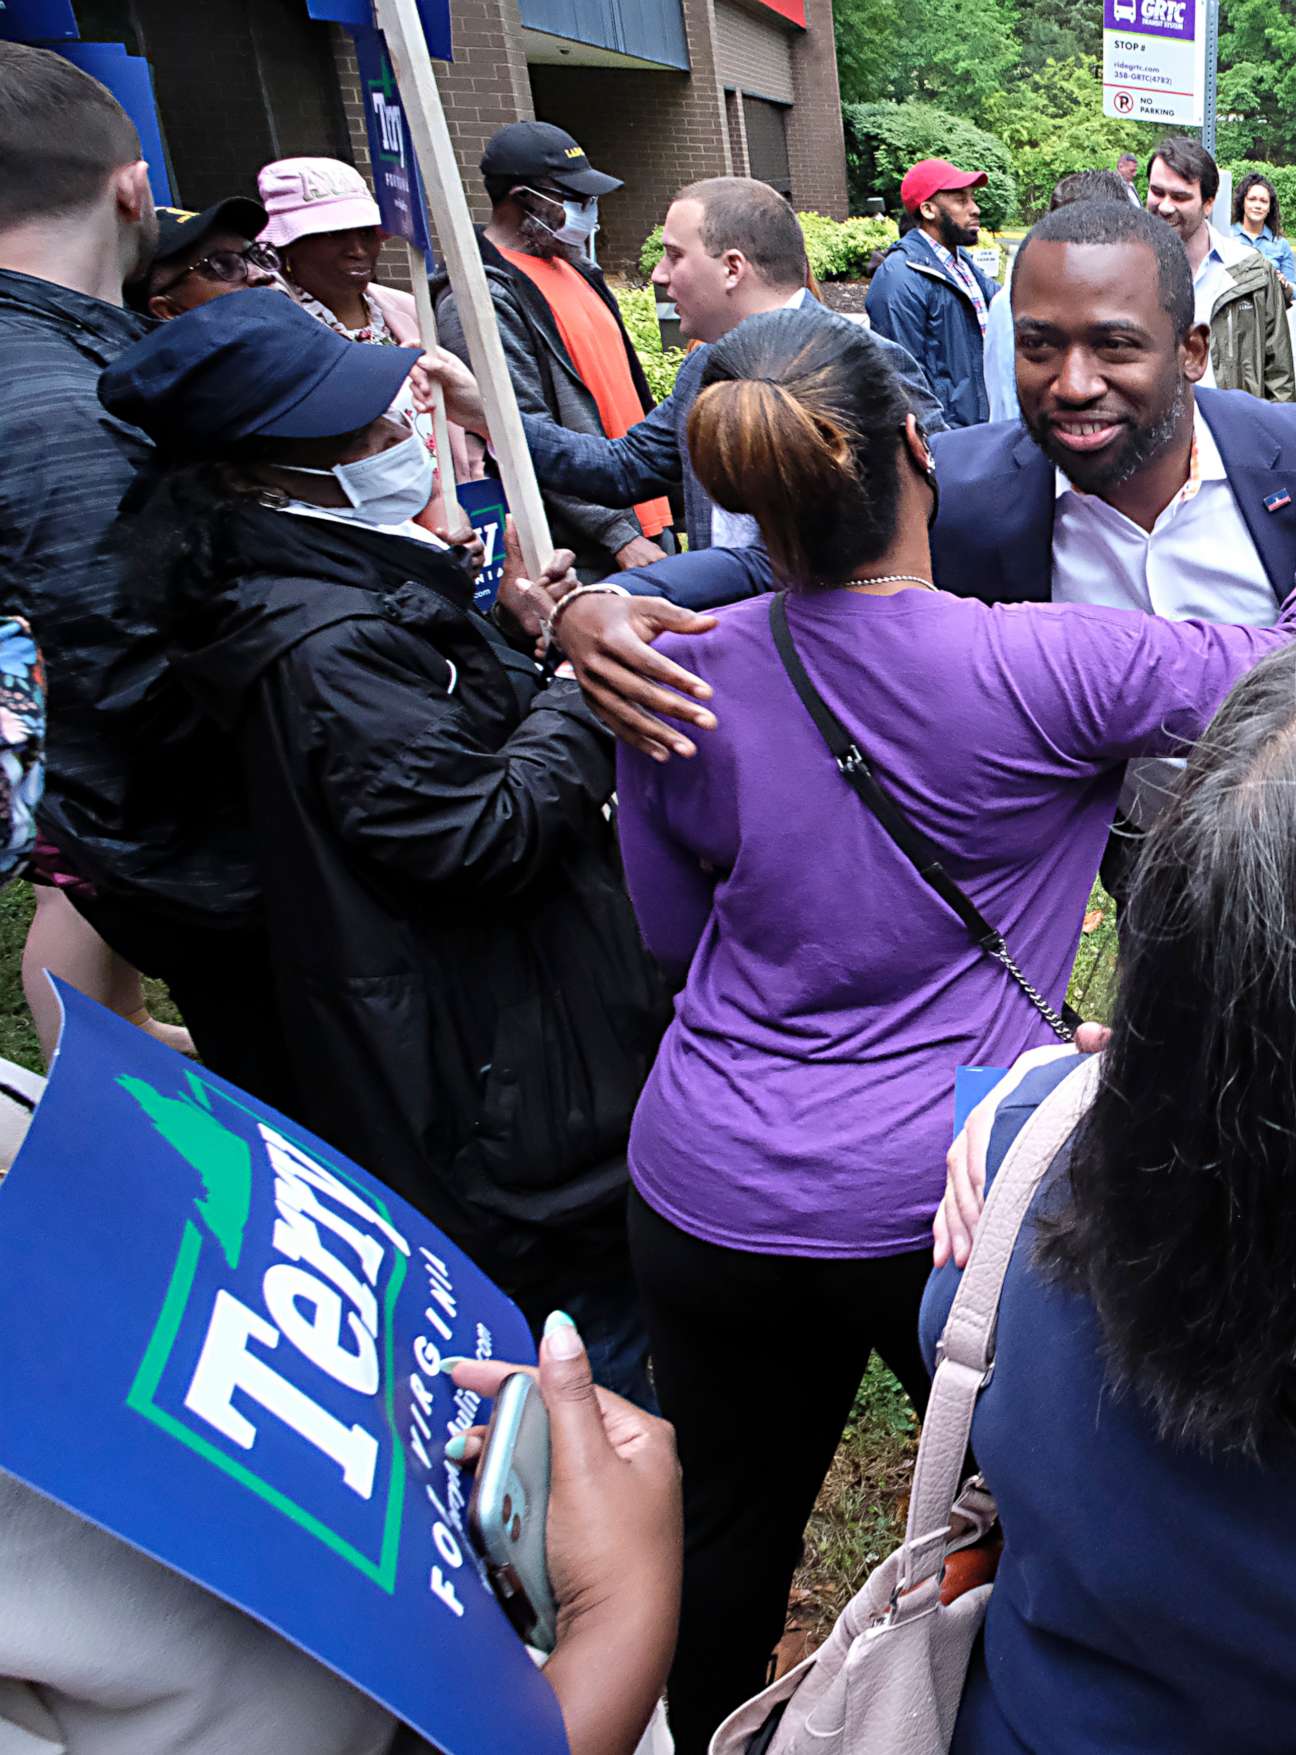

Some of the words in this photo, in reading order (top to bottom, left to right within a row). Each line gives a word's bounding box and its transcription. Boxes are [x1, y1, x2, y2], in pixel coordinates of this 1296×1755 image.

[1141, 0, 1187, 24] GRTC
[1114, 40, 1139, 50] STOP
[1114, 62, 1160, 73] ridegrtc.com
[1140, 97, 1153, 105] NO
[1140, 106, 1175, 116] PARKING
[184, 1122, 411, 1500] Terry
